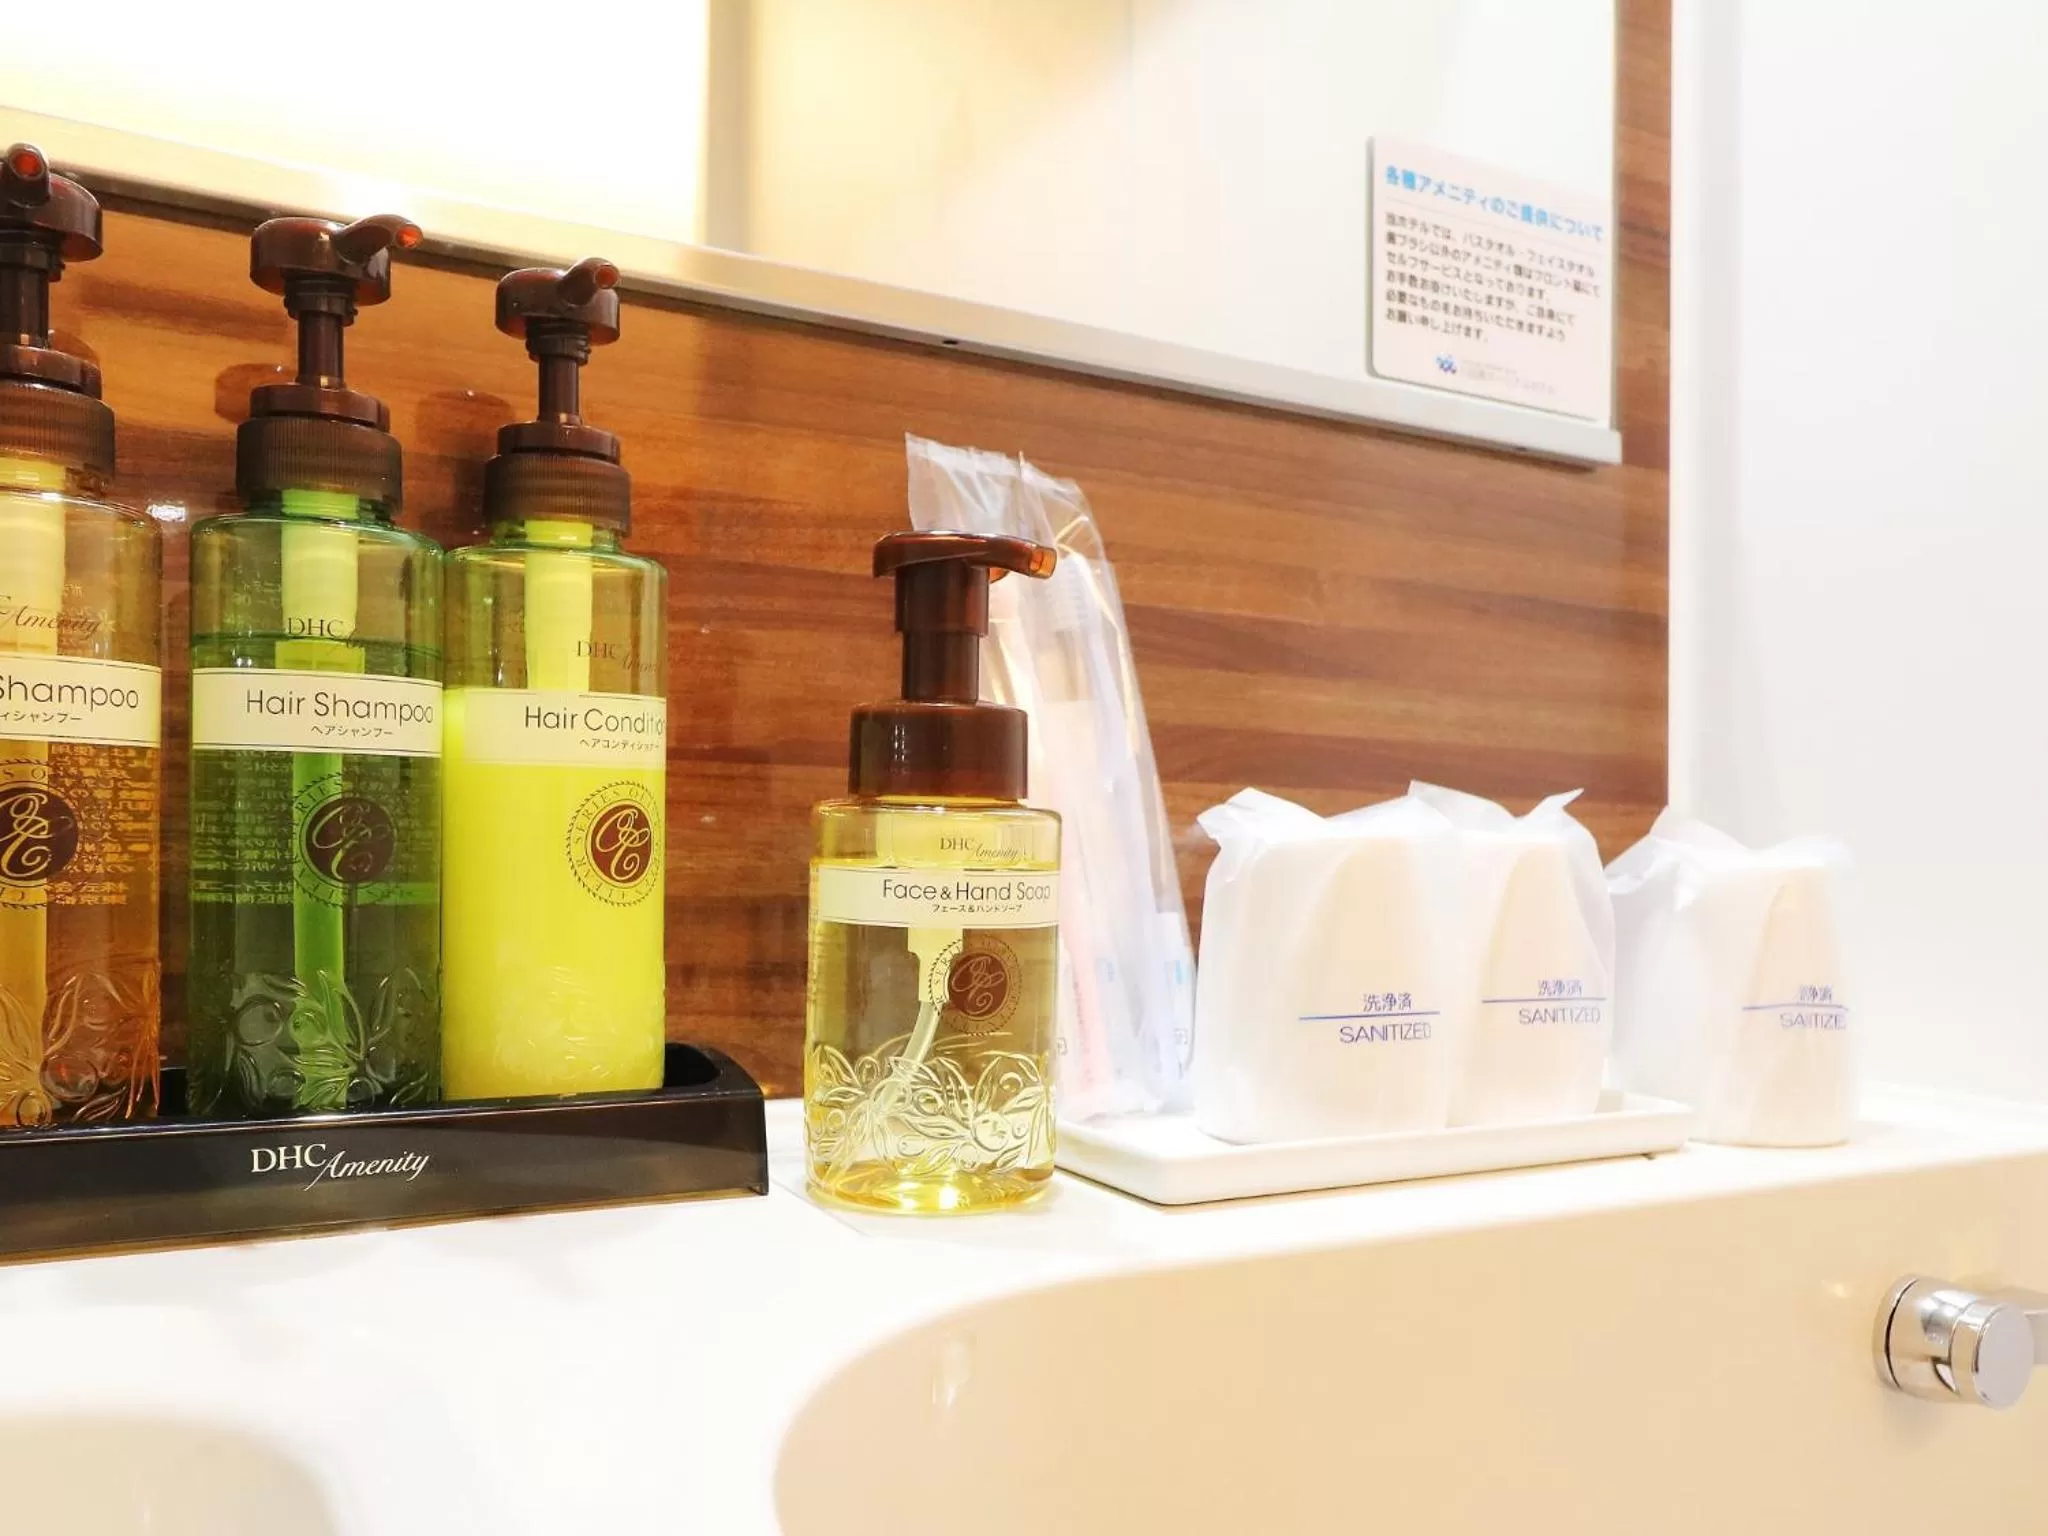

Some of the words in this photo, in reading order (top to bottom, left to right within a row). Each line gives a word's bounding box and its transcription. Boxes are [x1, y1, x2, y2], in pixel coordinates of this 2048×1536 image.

[287, 617, 344, 637] DHC
[576, 640, 618, 660] DHC
[0, 675, 140, 713] hampoo
[246, 688, 306, 717] Hair
[313, 691, 434, 727] Shampoo
[524, 705, 579, 731] Hair
[310, 724, 394, 738] ヘアシャンプー
[939, 836, 975, 851] DHC
[882, 878, 938, 900] Face
[956, 881, 1013, 901] Hand
[1016, 881, 1051, 903] Soap
[1362, 992, 1413, 1013] 洗浄済
[1518, 1006, 1601, 1025] SANITIZED
[1339, 1021, 1432, 1044] SANITIZED
[250, 1143, 327, 1173] DHC
[303, 1150, 430, 1192] Amenity
